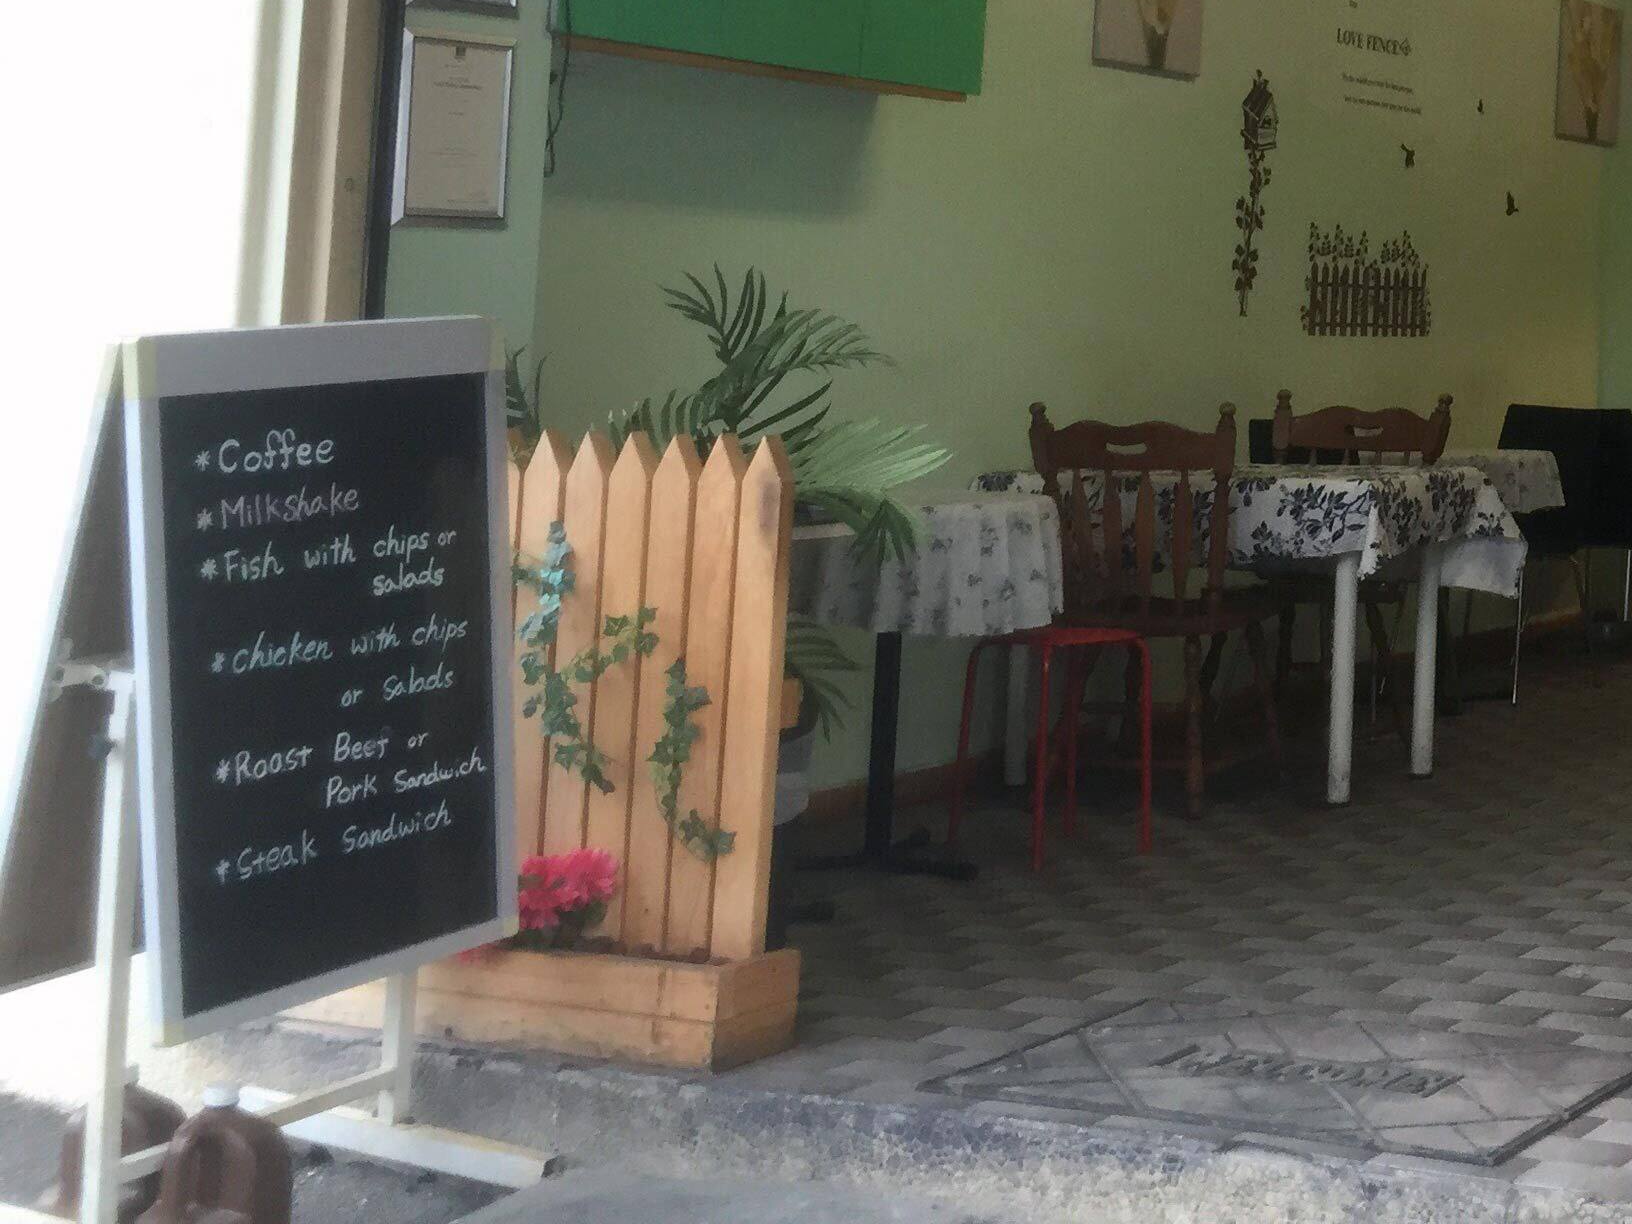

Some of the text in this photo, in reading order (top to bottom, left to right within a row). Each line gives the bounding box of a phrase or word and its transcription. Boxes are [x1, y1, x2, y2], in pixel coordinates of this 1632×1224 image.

[1337, 28, 1363, 50] LOVE
[218, 428, 334, 474] Coffee
[220, 482, 360, 529] Milkshake
[223, 524, 457, 582] Fish with chips or
[350, 622, 400, 656] with
[412, 613, 469, 653] chips
[340, 688, 363, 707] or
[333, 731, 389, 764] Beef
[408, 731, 429, 749] or
[325, 746, 487, 809] Pork Sandwich
[237, 798, 452, 880] Steak Sandwich
